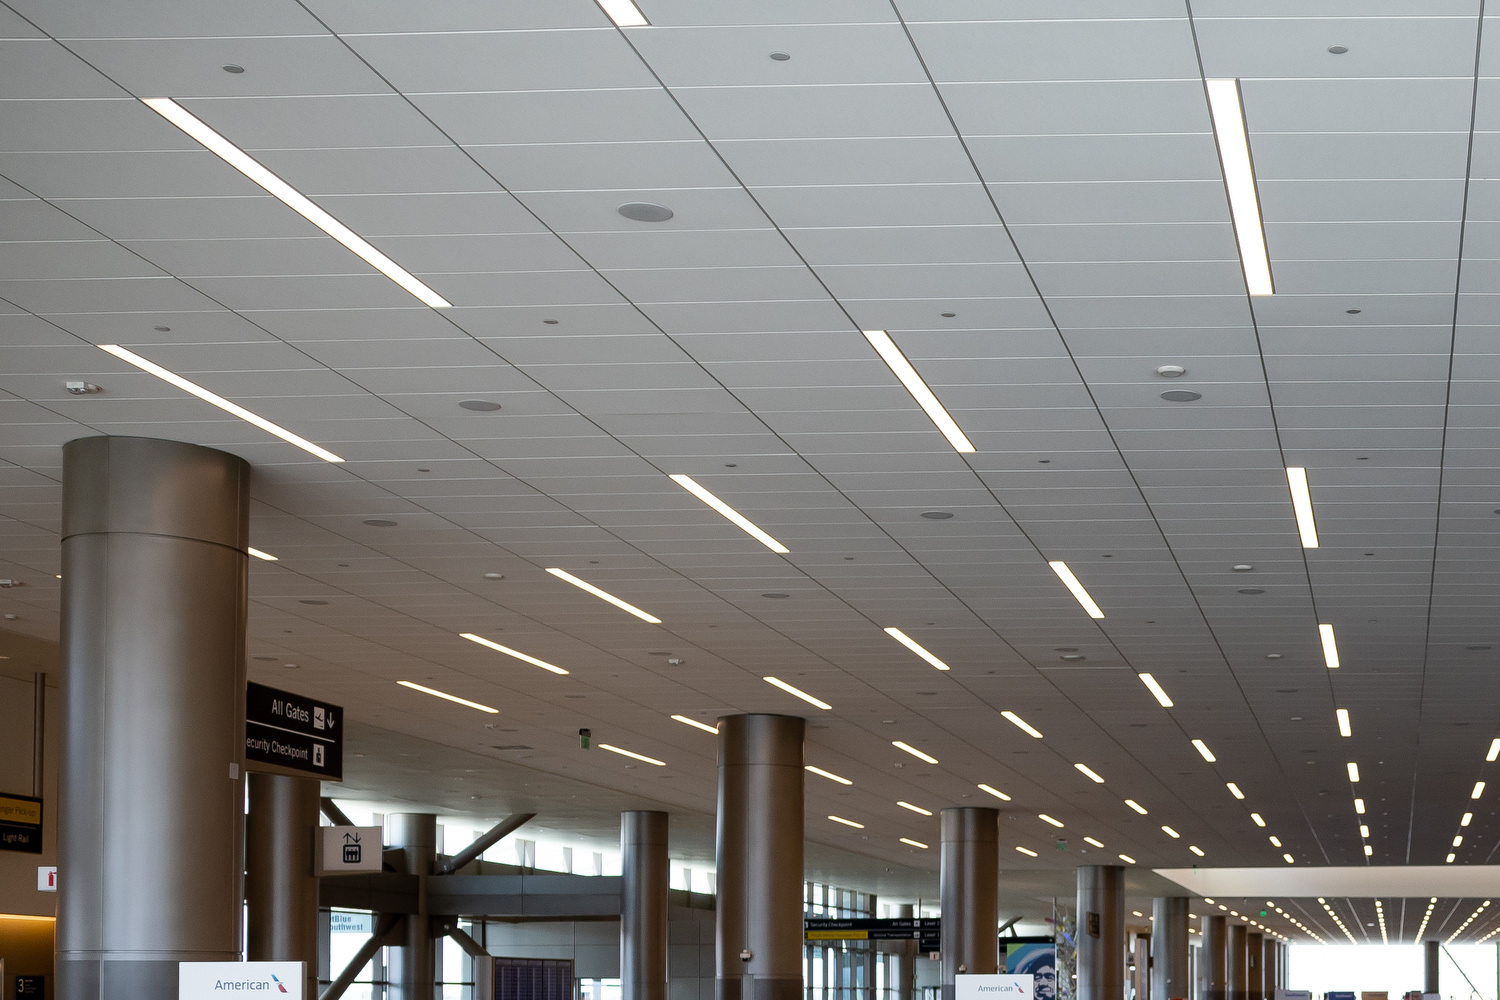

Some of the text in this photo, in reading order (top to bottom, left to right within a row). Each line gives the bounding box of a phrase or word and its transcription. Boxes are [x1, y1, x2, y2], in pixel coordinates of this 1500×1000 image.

[272, 699, 309, 722] All Gates
[246, 738, 308, 760] ecurity Checkpoint
[331, 915, 352, 923] tBlue
[330, 923, 363, 931] outhwest
[18, 978, 24, 993] 3
[214, 980, 270, 990] American
